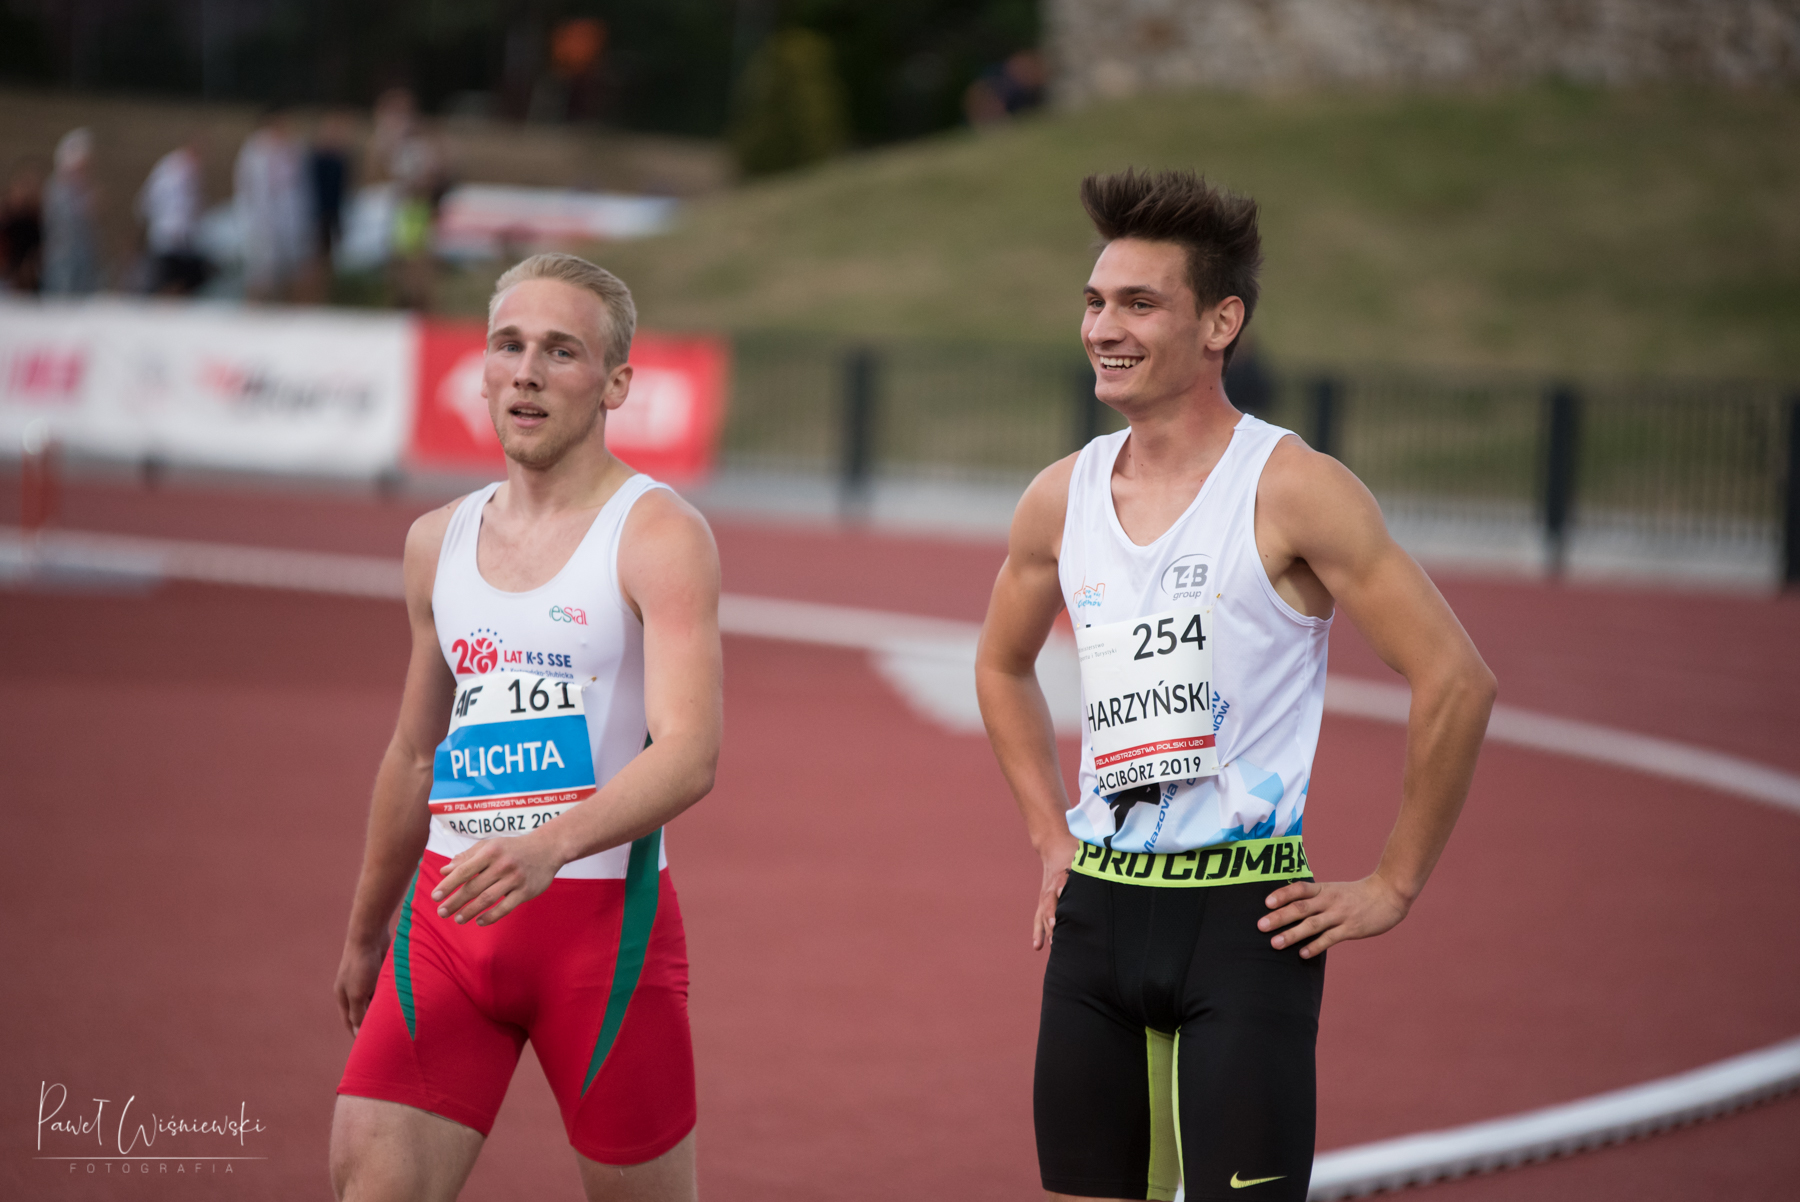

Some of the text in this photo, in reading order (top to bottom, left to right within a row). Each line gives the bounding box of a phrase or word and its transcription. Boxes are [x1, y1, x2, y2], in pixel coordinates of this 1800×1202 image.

[1172, 590, 1202, 602] group
[1132, 614, 1206, 661] 254
[503, 650, 523, 664] LAT
[526, 651, 544, 666] K-S
[547, 653, 572, 668] SSE
[507, 678, 575, 714] 161
[450, 740, 565, 780] PLICHTA
[1110, 746, 1156, 762] MISTRZOSTWA
[1156, 740, 1187, 751] POLSKI
[1188, 739, 1204, 748] U20
[1099, 756, 1201, 792] ACIBÓRZ 2019
[454, 801, 472, 811] PZLA
[473, 799, 527, 810] MISTRZOSTWA
[527, 796, 558, 805] POLSKI
[558, 793, 578, 801] U20
[449, 811, 561, 836] RACIBÓRZ 20
[1077, 841, 1311, 881] PRO COMBA
